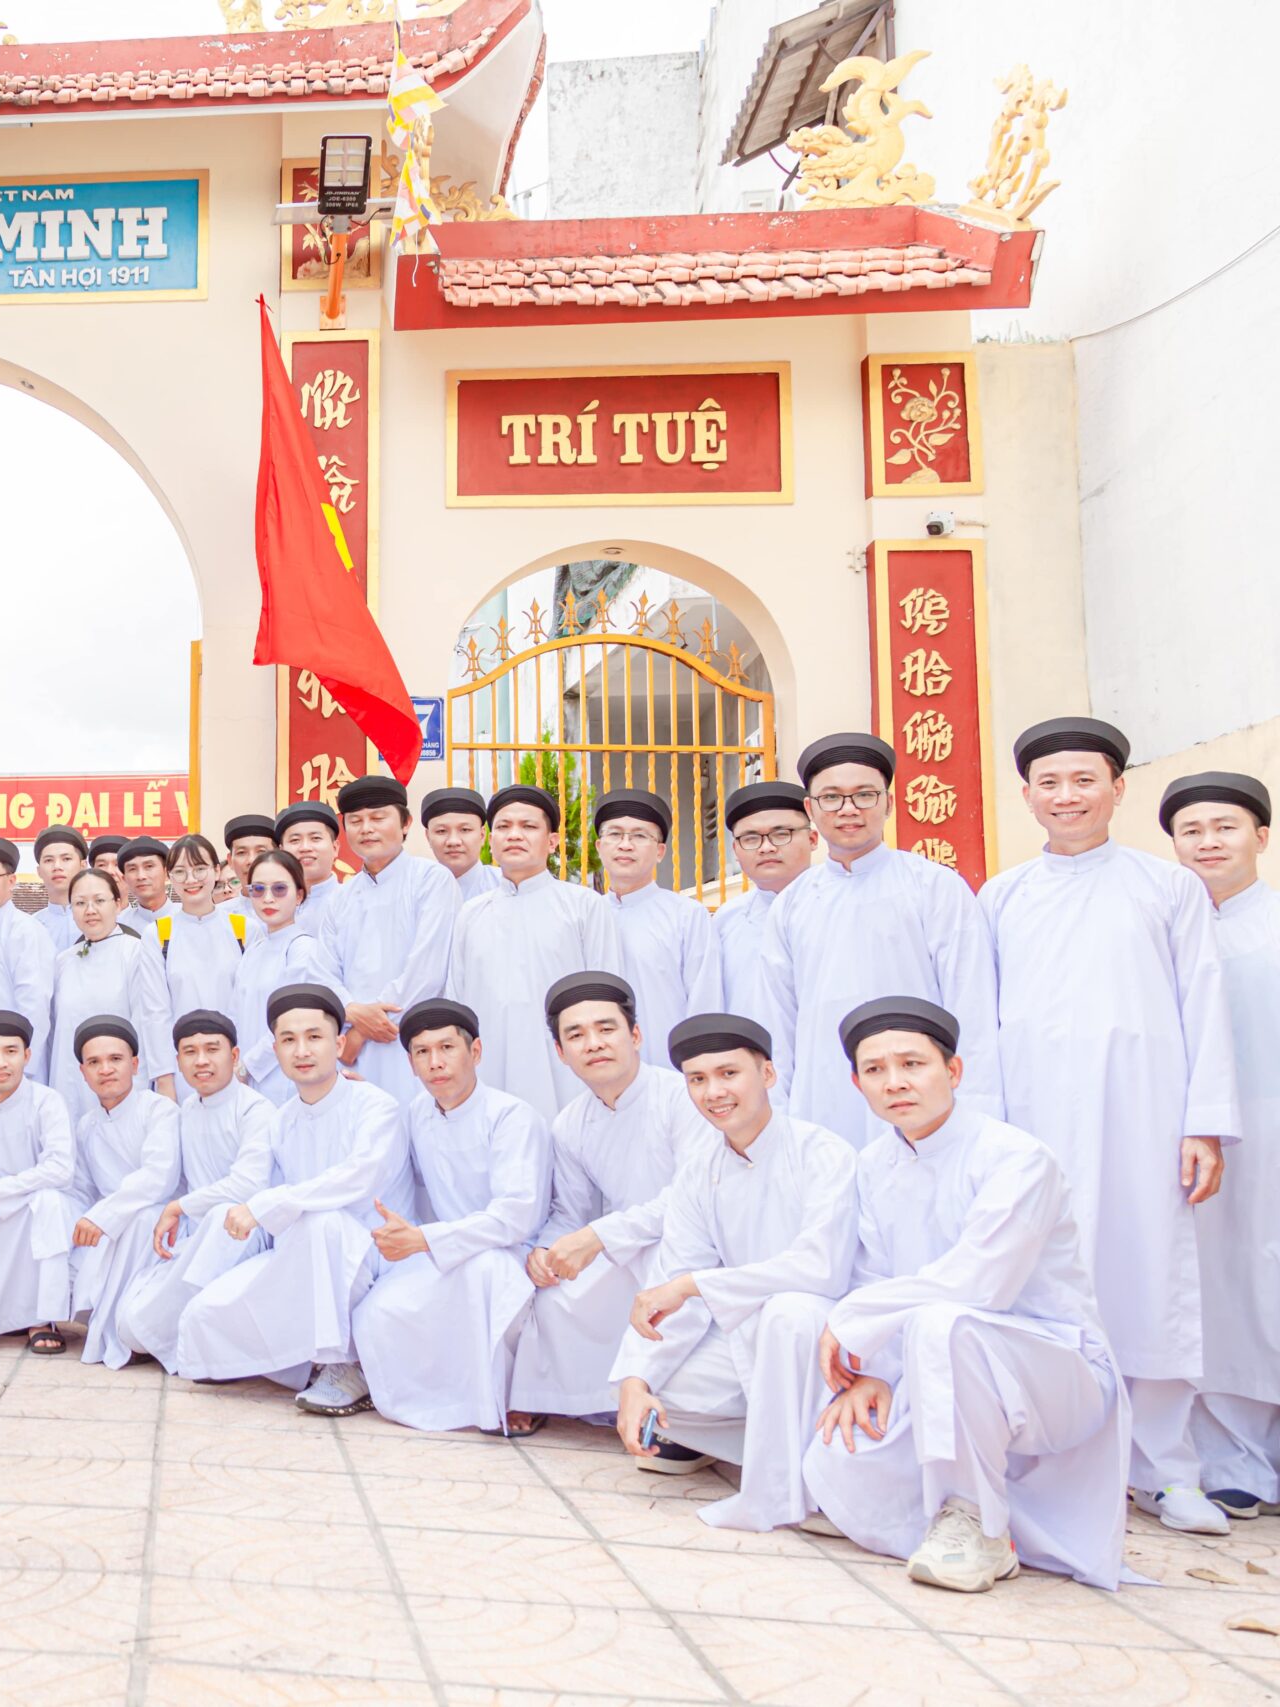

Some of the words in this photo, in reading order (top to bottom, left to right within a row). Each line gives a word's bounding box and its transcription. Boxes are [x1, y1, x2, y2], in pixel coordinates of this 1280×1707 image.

[22, 189, 75, 203] NAM
[8, 265, 56, 288] TÂN
[60, 265, 102, 290] HỢI
[107, 265, 150, 286] 1911
[500, 399, 600, 465] TRÍ
[612, 397, 728, 471] TUỆ
[45, 792, 110, 837] ĐẠI
[123, 779, 169, 828] LỄ
